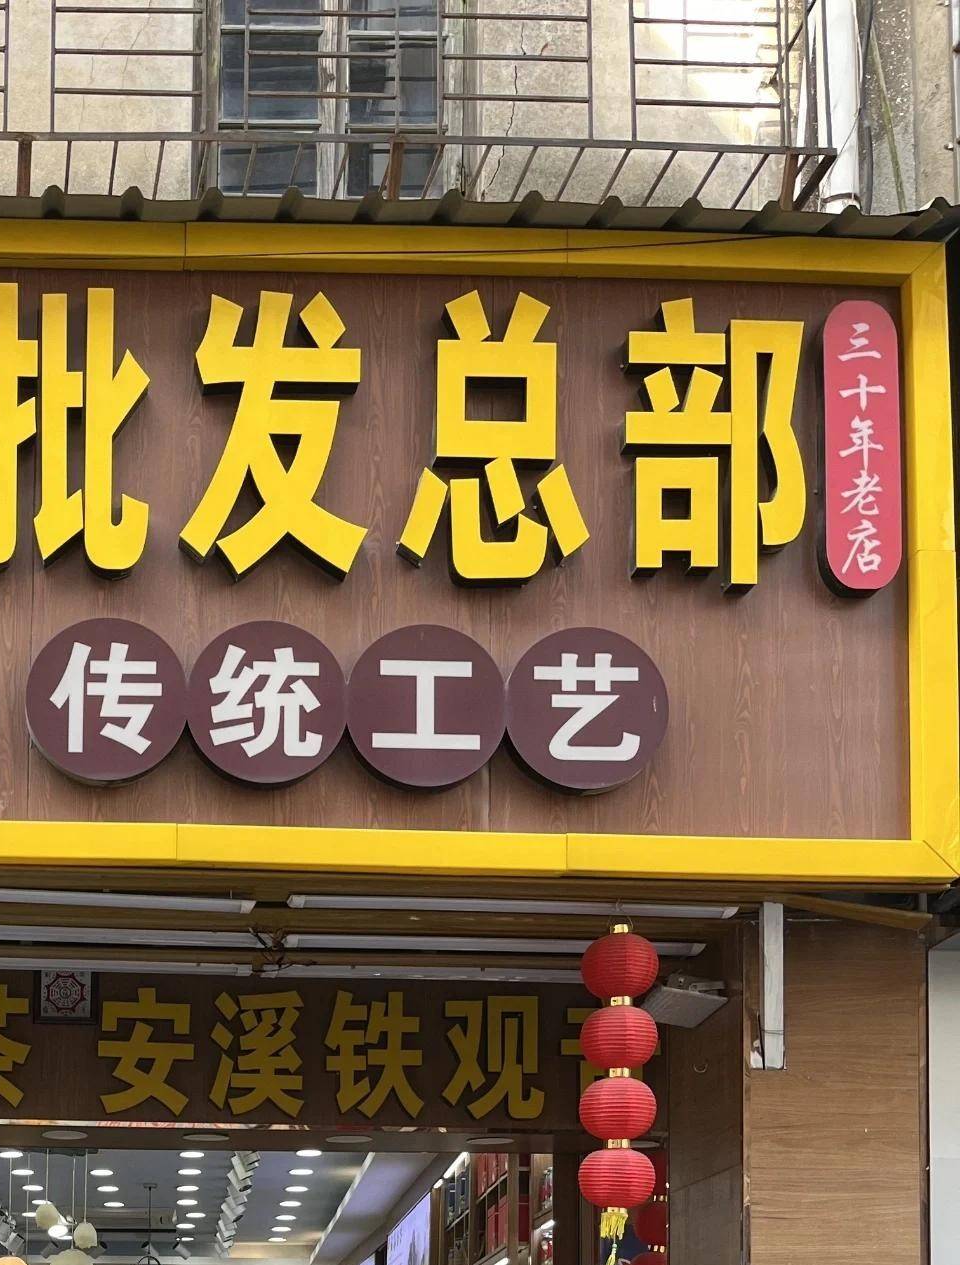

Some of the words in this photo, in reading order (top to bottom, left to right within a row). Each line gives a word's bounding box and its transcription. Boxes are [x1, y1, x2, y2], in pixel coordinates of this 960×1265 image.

[835, 321, 884, 575] 三十年老店
[49, 641, 642, 762] 传统工艺
